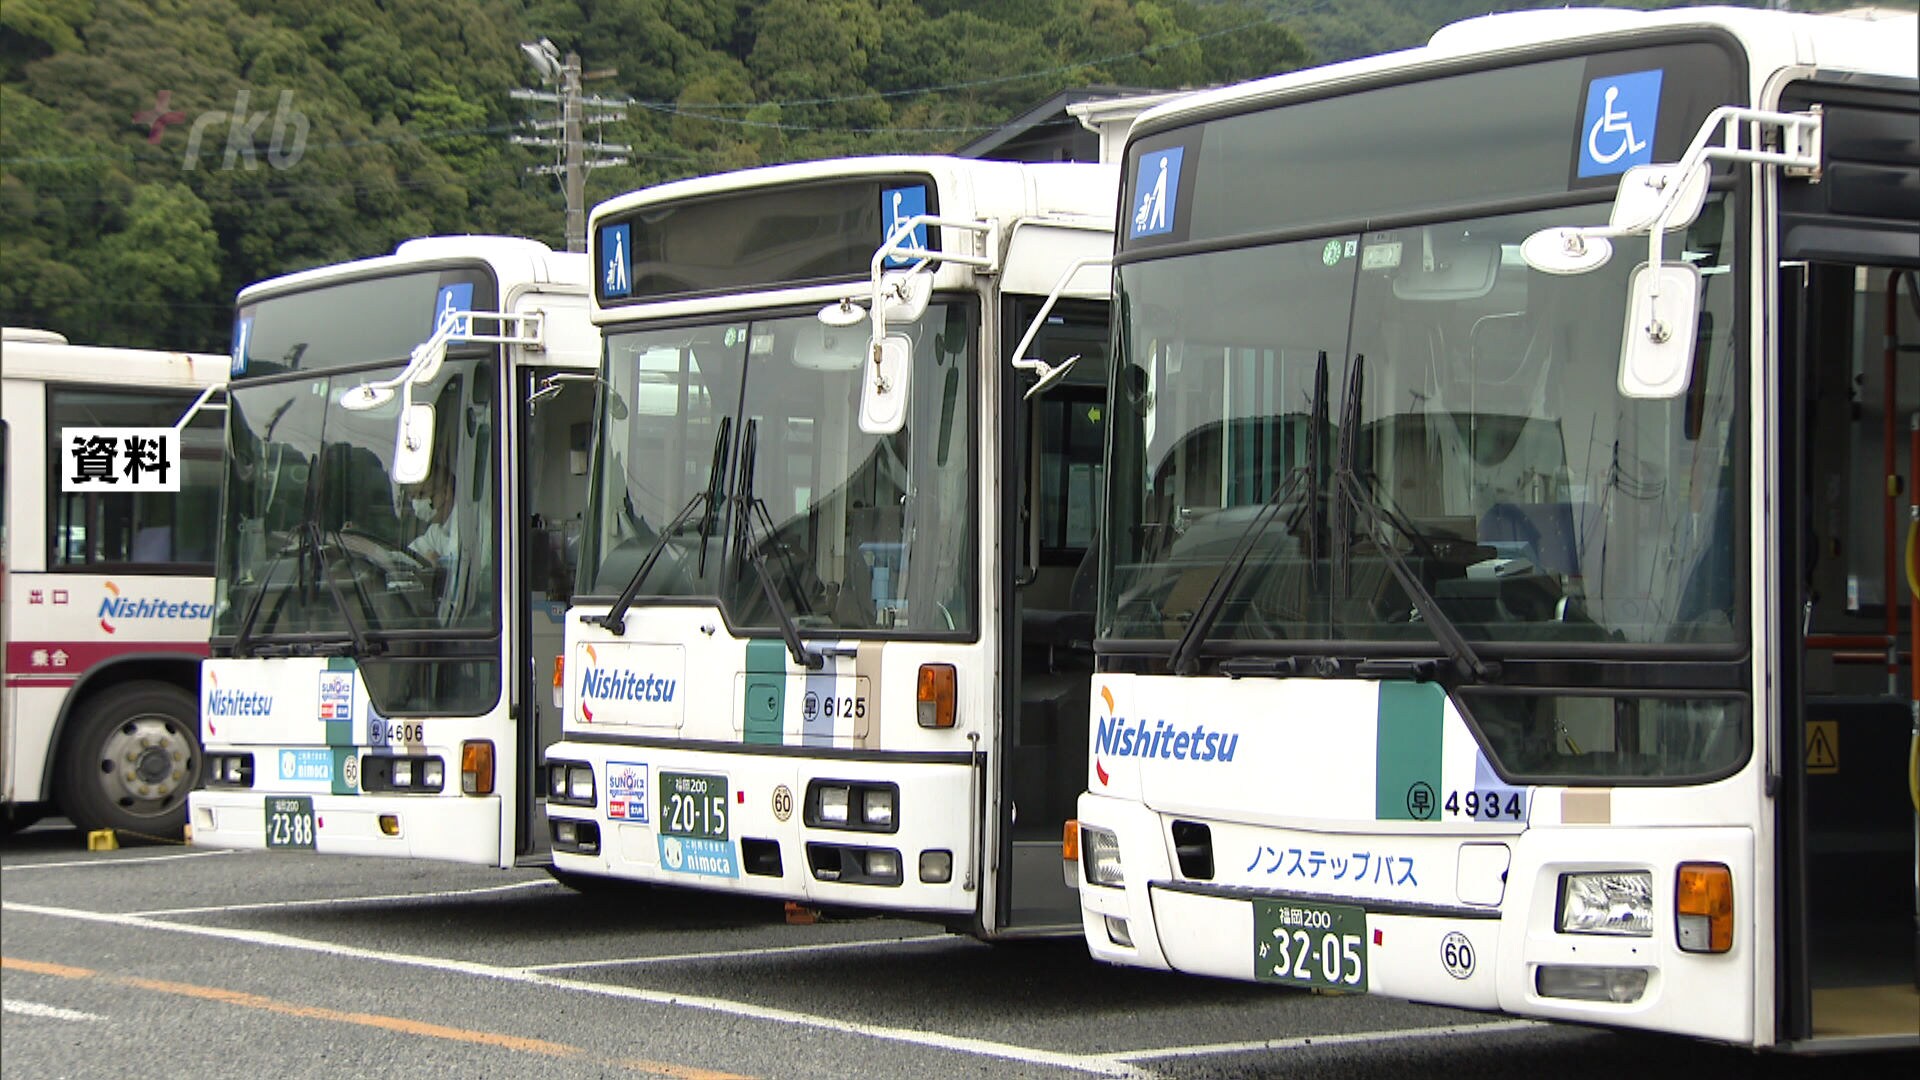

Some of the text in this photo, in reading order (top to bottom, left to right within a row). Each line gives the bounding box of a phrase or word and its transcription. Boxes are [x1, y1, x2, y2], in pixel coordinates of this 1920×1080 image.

[29, 589, 69, 605] 出口
[98, 597, 215, 619] Nishitetsu
[580, 667, 677, 702] Nishitetsu
[207, 689, 273, 717] Nishitetsu
[824, 697, 866, 718] 6125
[387, 724, 424, 743] 4606
[1095, 715, 1239, 762] Nishitetsu
[346, 764, 358, 780] 60
[671, 793, 726, 835] 20-15
[775, 793, 791, 812] 60
[1444, 790, 1522, 821] 4934
[272, 813, 313, 844] 23-88
[687, 848, 730, 874] nimoca
[1246, 846, 1418, 887] ノンステップバス
[1278, 907, 1331, 928] 福岡200
[1258, 927, 1362, 985] か 32-05
[1445, 943, 1472, 969] 60
